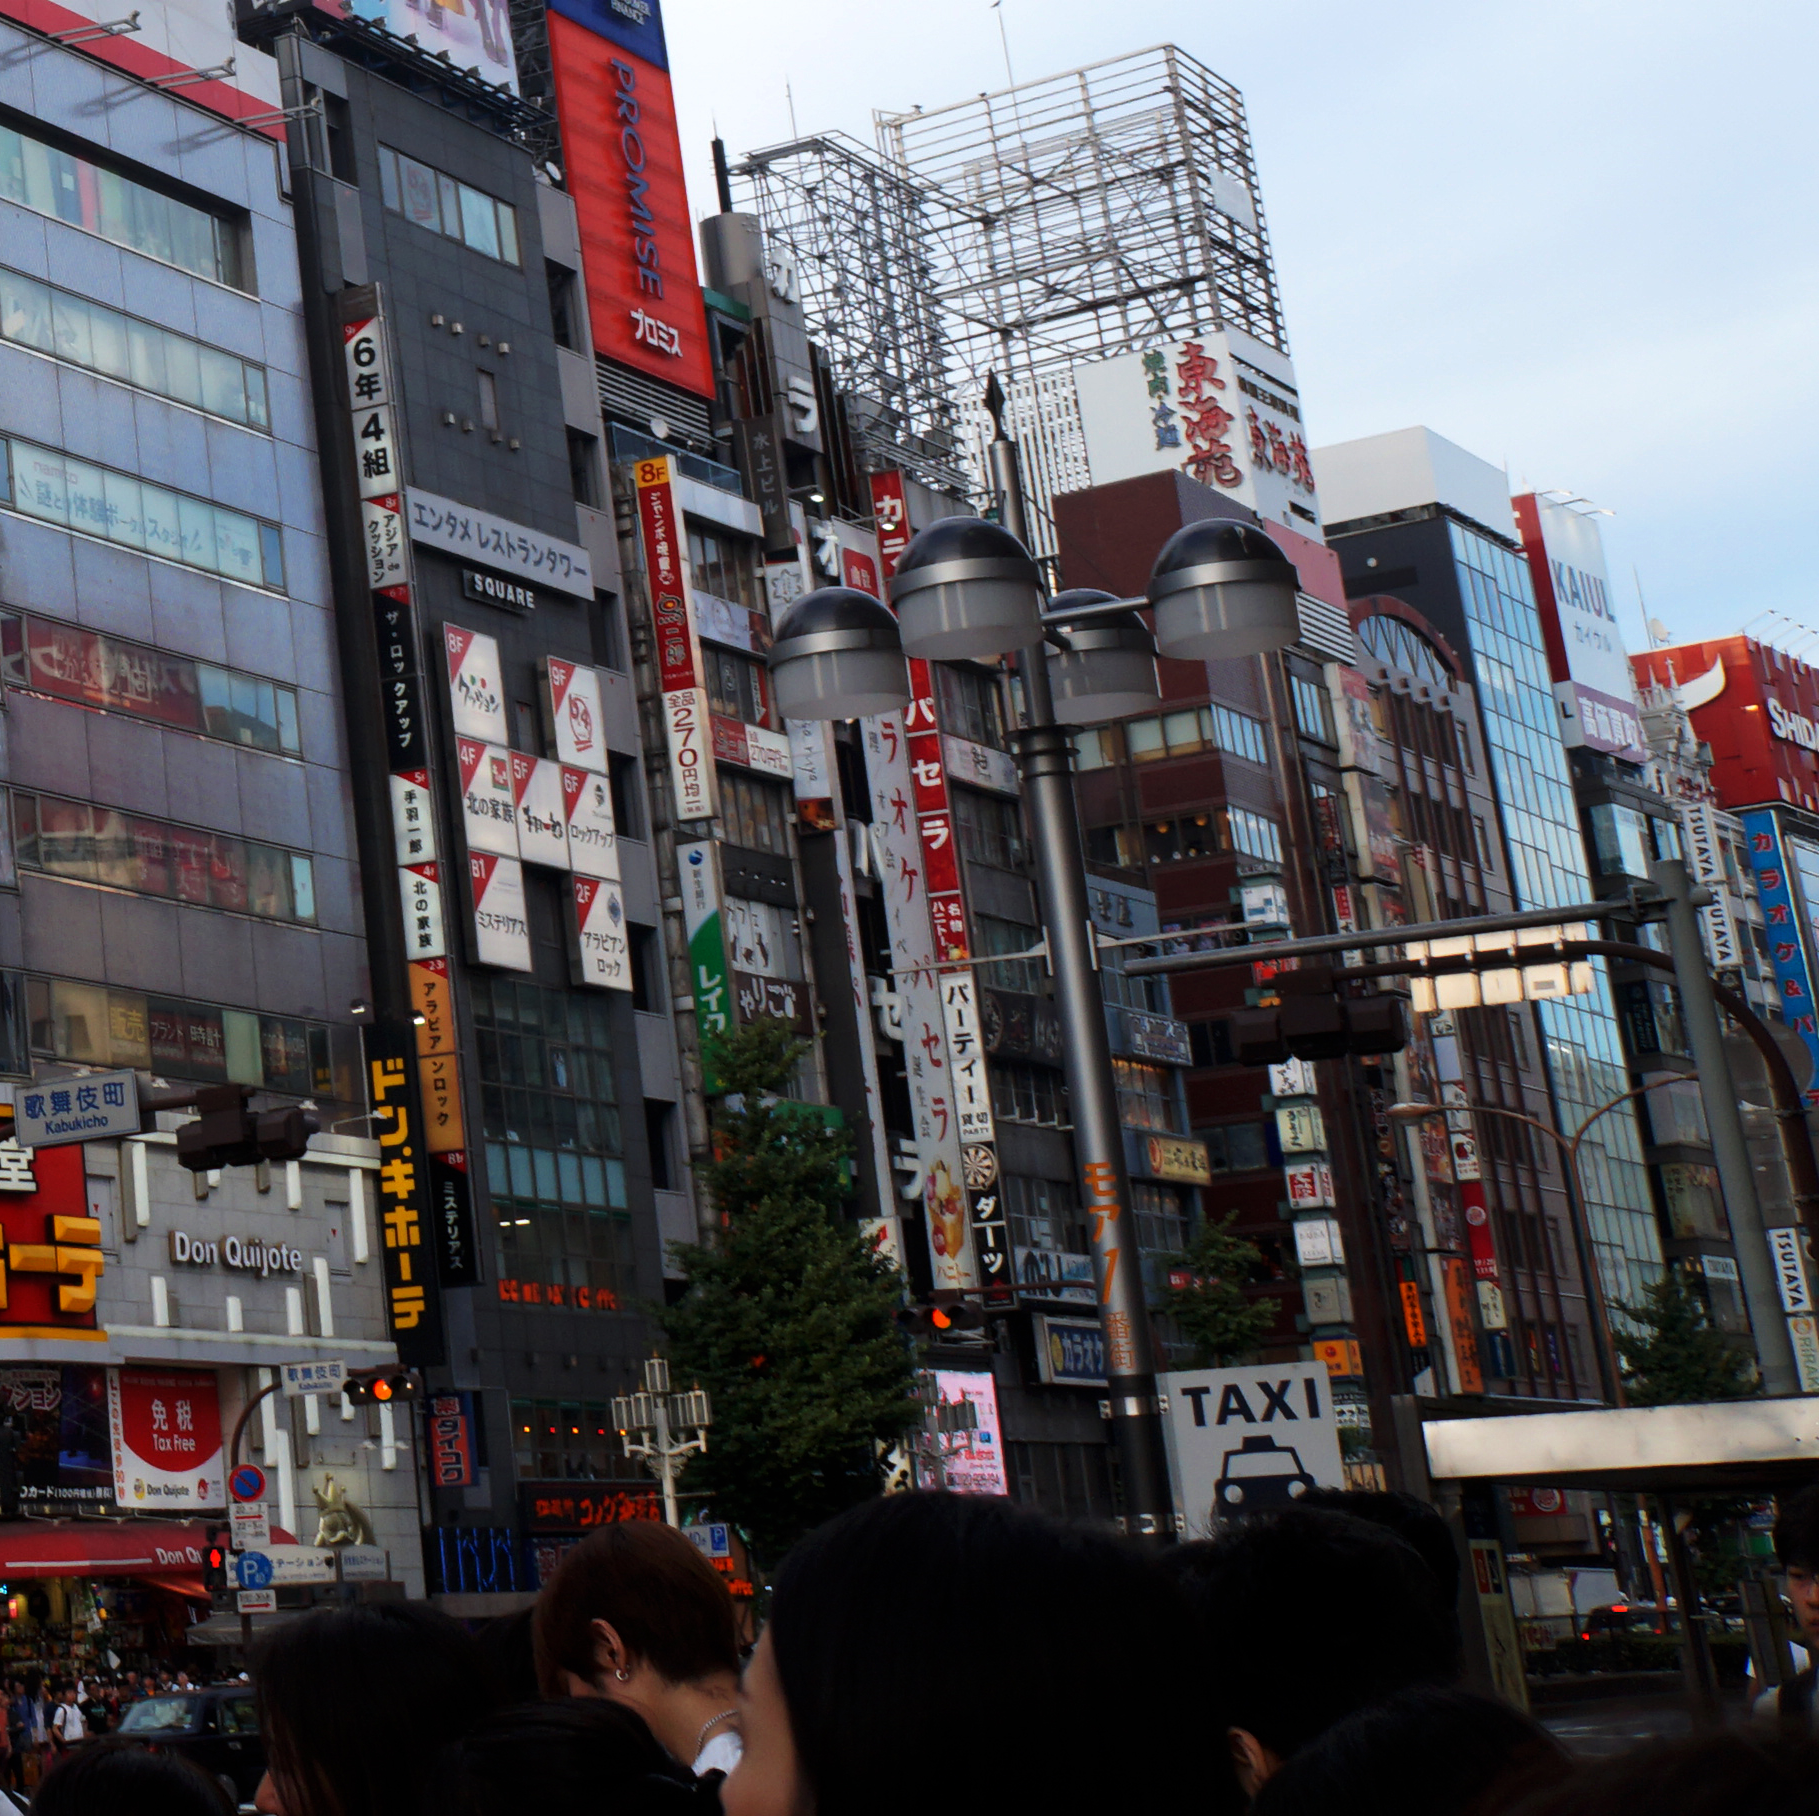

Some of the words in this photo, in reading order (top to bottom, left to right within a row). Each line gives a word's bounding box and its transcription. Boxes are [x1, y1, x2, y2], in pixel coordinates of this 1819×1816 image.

[609, 56, 664, 302] PROMISE
[629, 308, 684, 359] プロミス
[640, 462, 665, 483] 8F
[413, 502, 472, 541] エンタメ
[477, 522, 588, 579] レストランタワー
[473, 572, 536, 610] SQUARE
[1551, 559, 1616, 623] KAIUL
[448, 632, 464, 653] 8F
[551, 665, 567, 685] 9F
[460, 744, 476, 767] 4F
[513, 759, 528, 780] 5F
[564, 773, 579, 794] 6F
[405, 788, 424, 855] 手羽一郎
[1687, 807, 1714, 879] TSUTAYA
[471, 858, 487, 880] B1
[575, 883, 591, 903] 2F
[413, 882, 433, 949] 北の家族
[596, 958, 622, 977] ロック
[23, 1083, 125, 1120] 歌舞伎町
[45, 1113, 109, 1136] Kabukicho
[440, 1179, 463, 1271] ミステリアス
[172, 1229, 219, 1266] Don
[224, 1235, 304, 1274] Quijote
[1774, 1230, 1805, 1309] TSUTAYA
[286, 1365, 342, 1382] 歌舞伎町
[151, 1398, 193, 1432] 免税
[1181, 1376, 1324, 1428] TAXI
[152, 1434, 173, 1452] Tax
[173, 1433, 196, 1452] Free
[146, 1484, 162, 1497] Don
[162, 1484, 190, 1498] Quijote
[155, 1546, 182, 1566] Don
